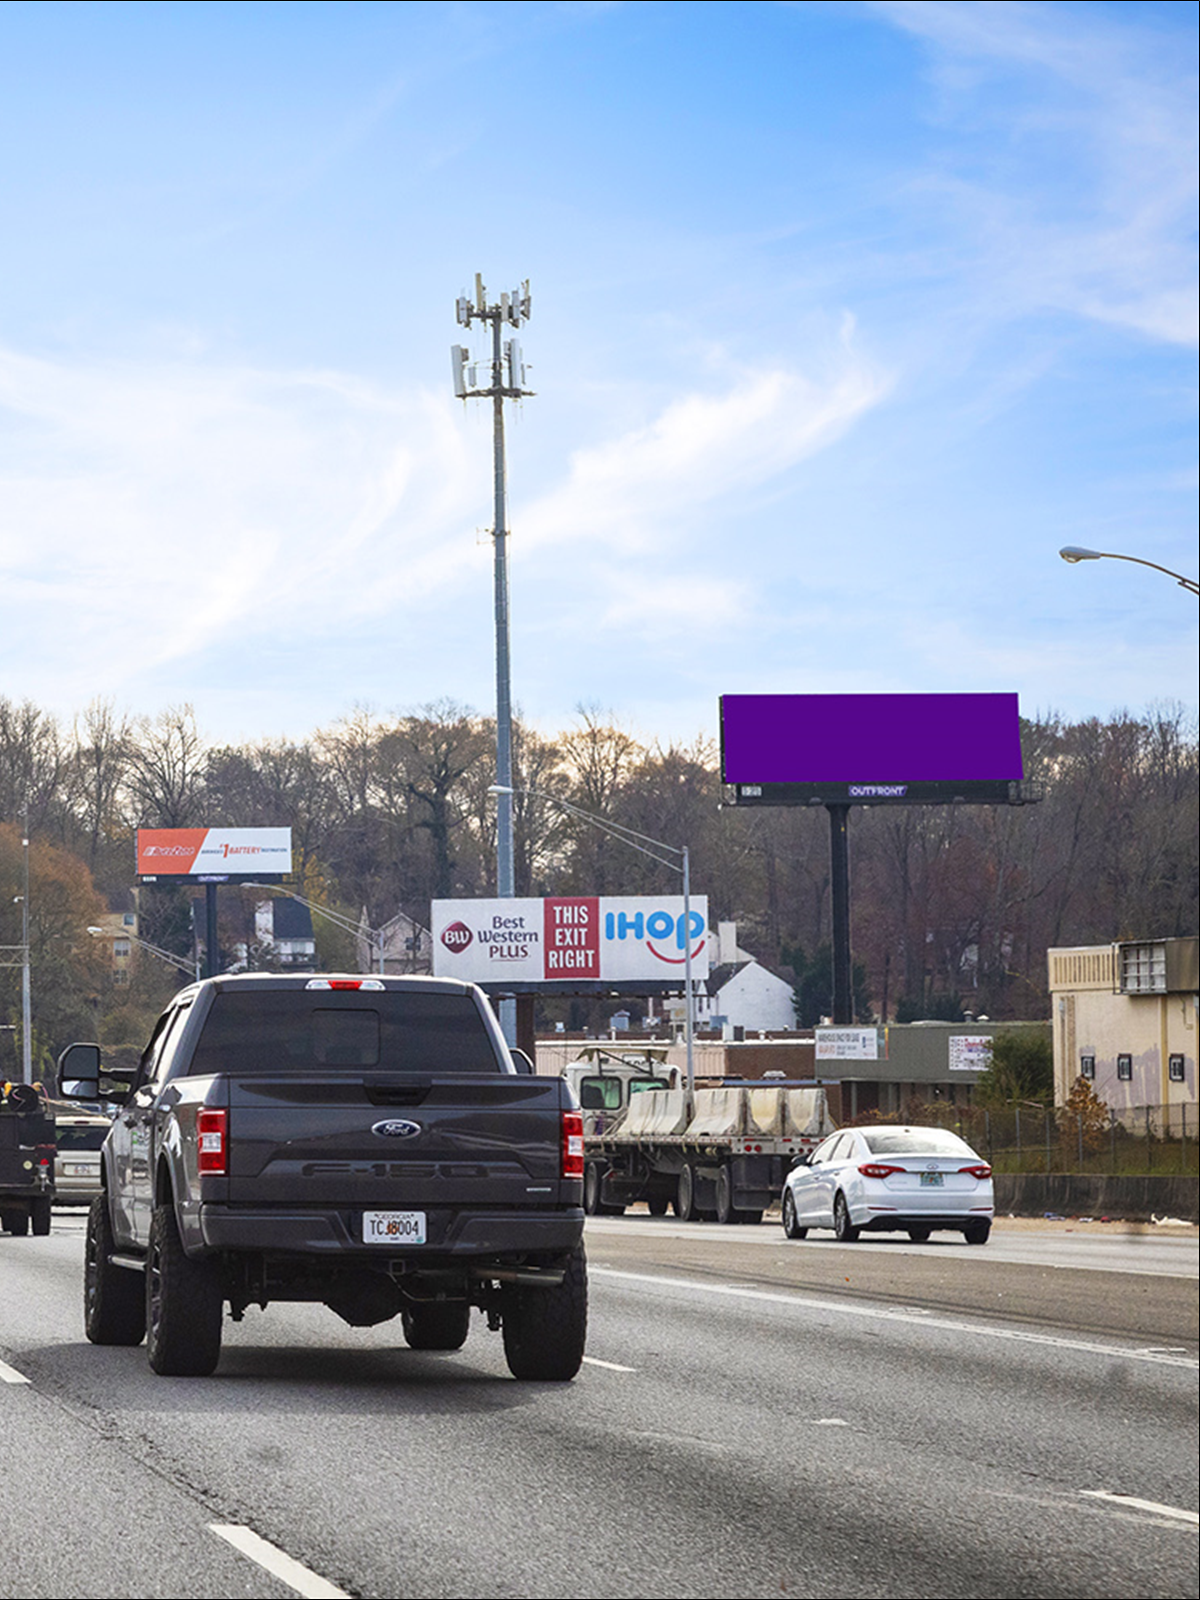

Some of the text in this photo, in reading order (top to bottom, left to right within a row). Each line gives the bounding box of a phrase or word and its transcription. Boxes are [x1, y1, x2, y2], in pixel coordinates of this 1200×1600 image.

[850, 786, 904, 796] OUTFRONT
[229, 846, 261, 855] BATTERY
[553, 906, 589, 924] THIS
[492, 916, 525, 929] Best
[444, 930, 470, 945] BW
[478, 929, 538, 943] Western
[555, 928, 588, 946] EXIT
[489, 945, 529, 958] PLUS
[549, 950, 595, 969] RIGHT
[383, 1123, 410, 1135] Ford
[301, 1162, 490, 1179] F-150
[370, 1220, 419, 1236] TCJ8004
